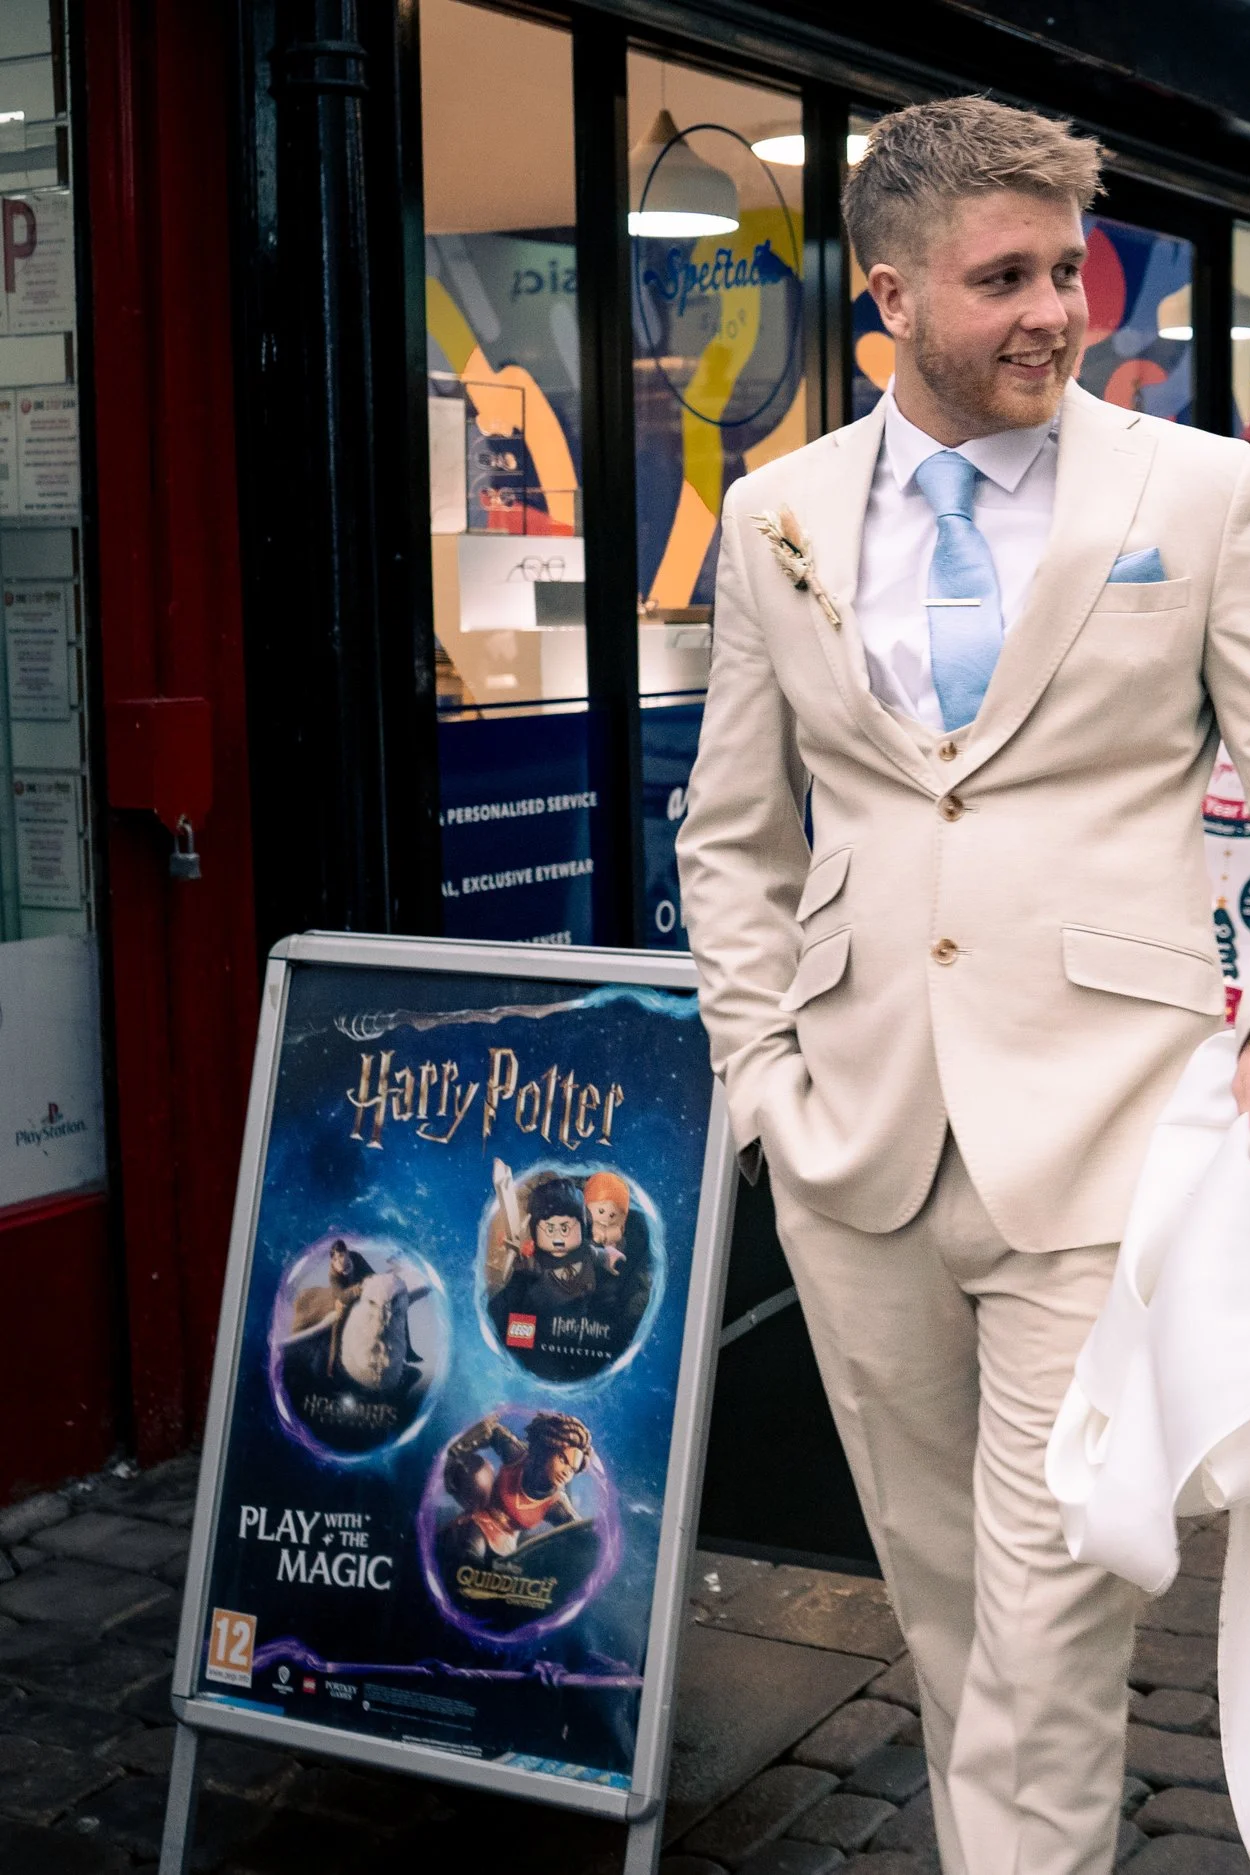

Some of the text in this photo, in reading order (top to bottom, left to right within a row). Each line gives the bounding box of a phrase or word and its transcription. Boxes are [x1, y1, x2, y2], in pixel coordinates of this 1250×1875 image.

[447, 797, 545, 824] PERSONALISED
[546, 791, 598, 813] SERVICE
[461, 868, 533, 894] EXCLUSIVE
[535, 857, 594, 882] EYEWEAR
[347, 1047, 625, 1154] Harry Potter
[15, 1121, 87, 1146] PlayStation
[540, 1343, 613, 1359] COLLECTION
[238, 1505, 362, 1545] PLAY WITH
[339, 1531, 369, 1548] THE
[276, 1548, 393, 1590] MAGIC
[456, 1565, 554, 1601] QUIDDITCH
[215, 1616, 251, 1667] 12
